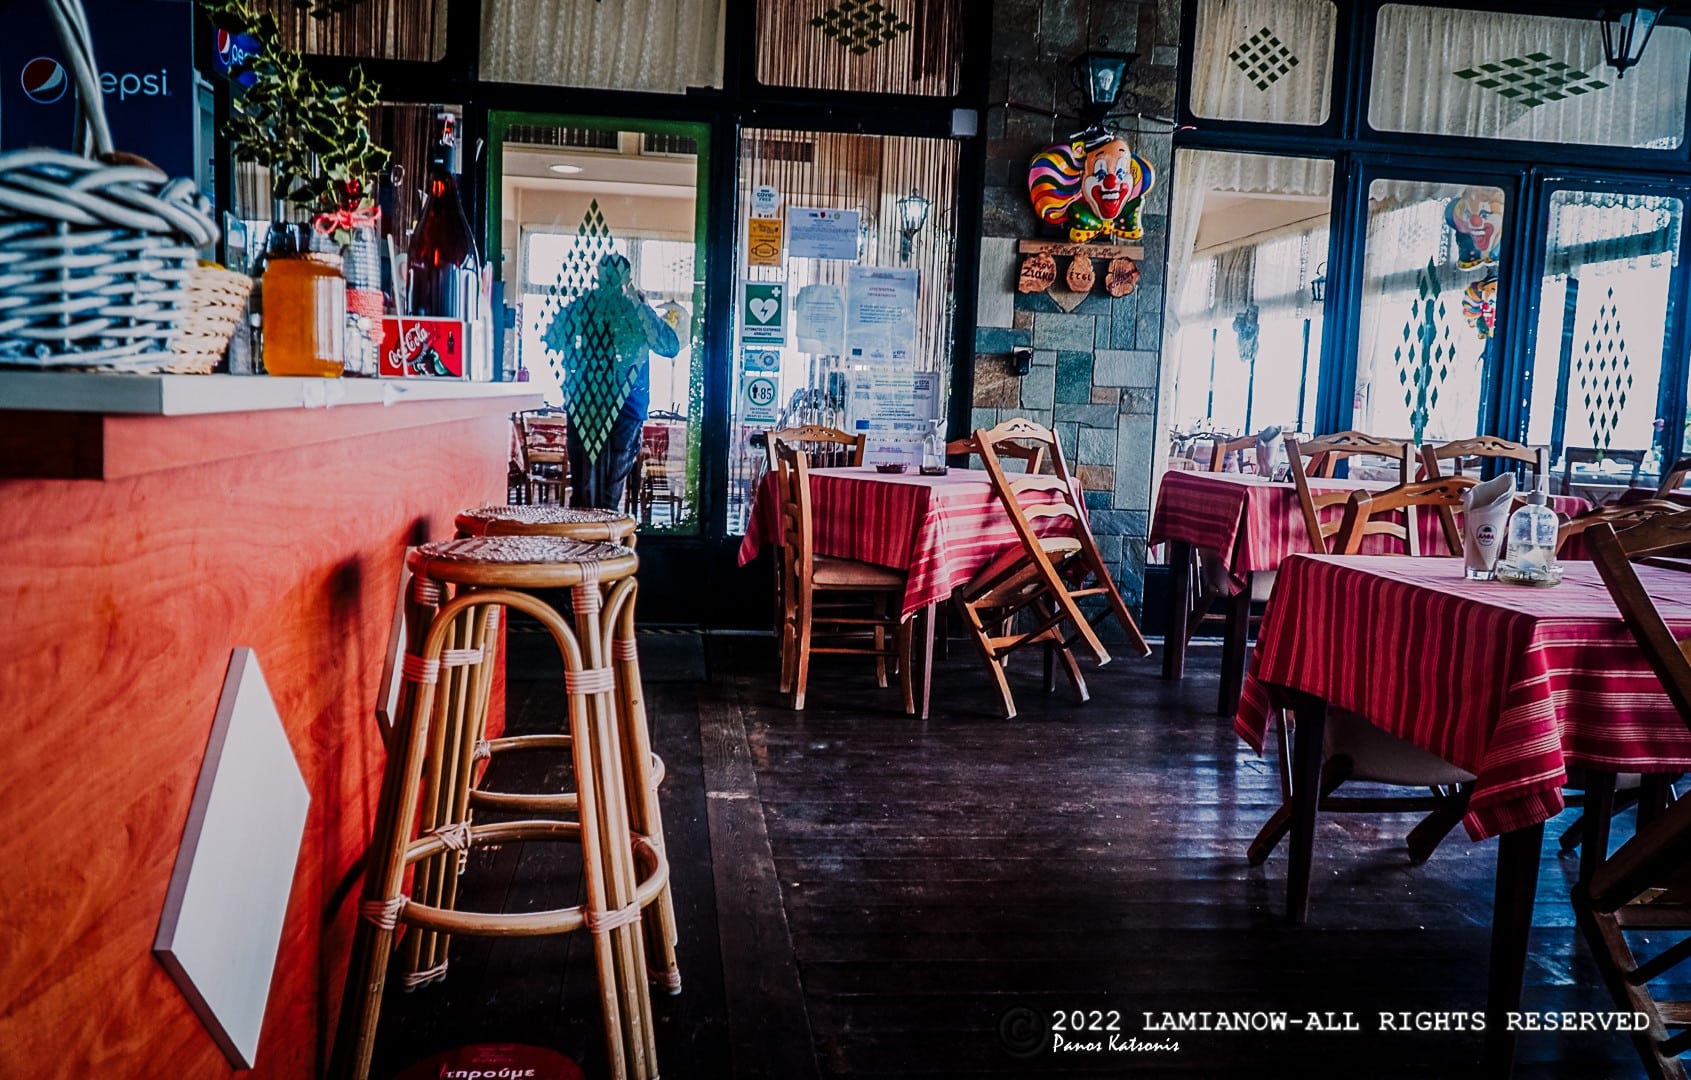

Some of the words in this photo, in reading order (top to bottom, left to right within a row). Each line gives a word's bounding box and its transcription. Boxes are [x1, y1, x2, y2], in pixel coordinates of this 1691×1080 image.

[100, 69, 167, 101] epsi
[760, 387, 772, 400] 85
[446, 1067, 536, 1080] τηρούμε
